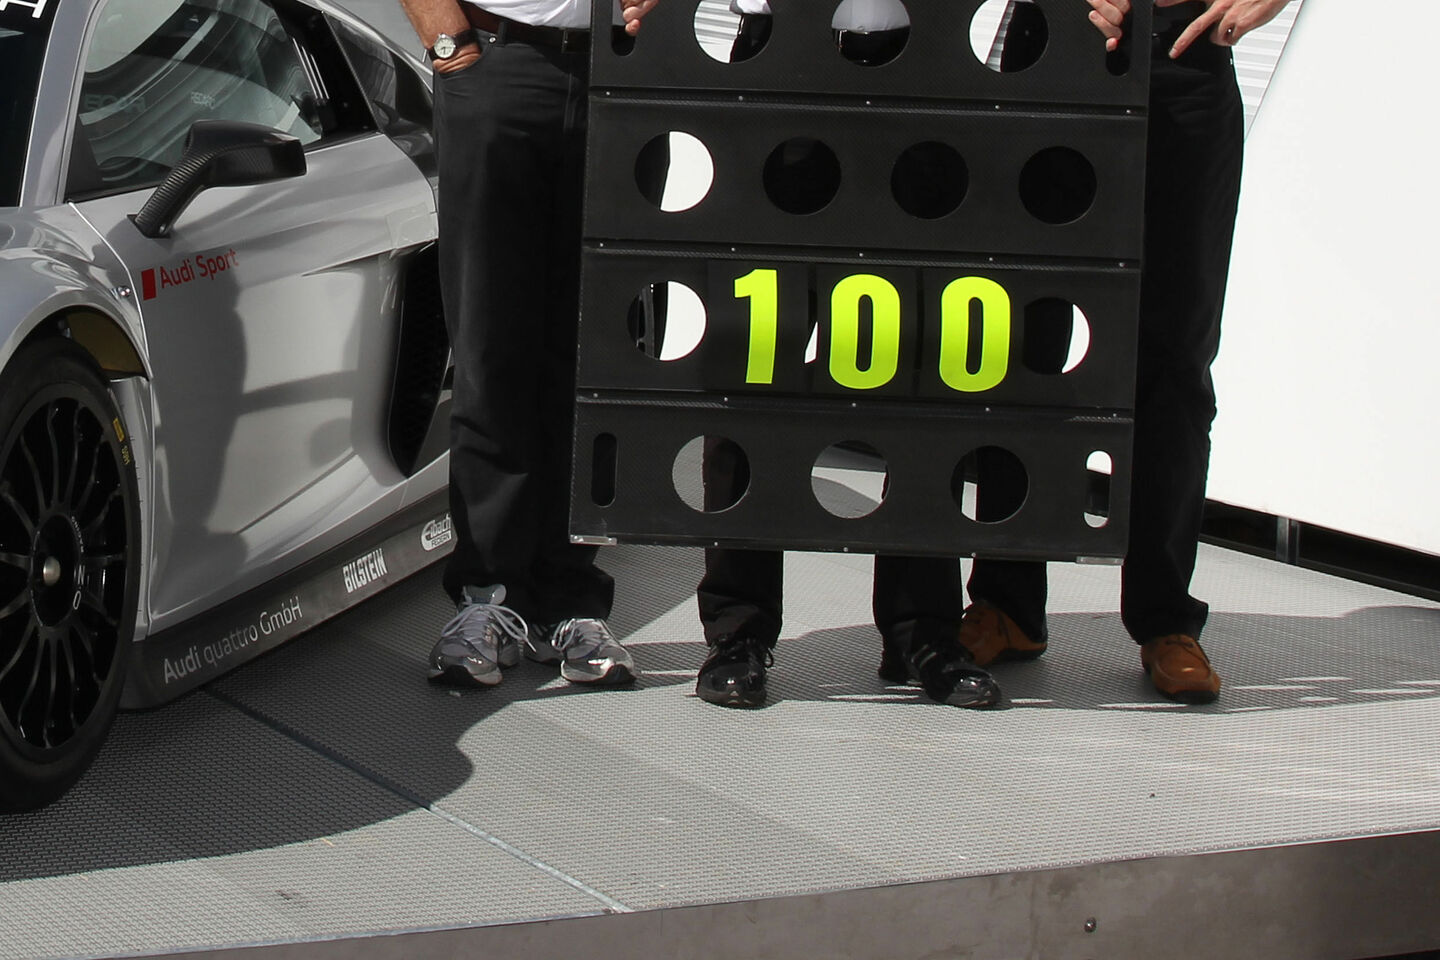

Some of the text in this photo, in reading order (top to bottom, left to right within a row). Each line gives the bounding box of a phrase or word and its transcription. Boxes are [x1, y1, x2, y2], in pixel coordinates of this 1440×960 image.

[160, 247, 239, 289] Audi Sport
[733, 268, 1012, 393] 100
[342, 547, 389, 594] BILSTEIN
[163, 595, 304, 684] Audi quattro GmbH
